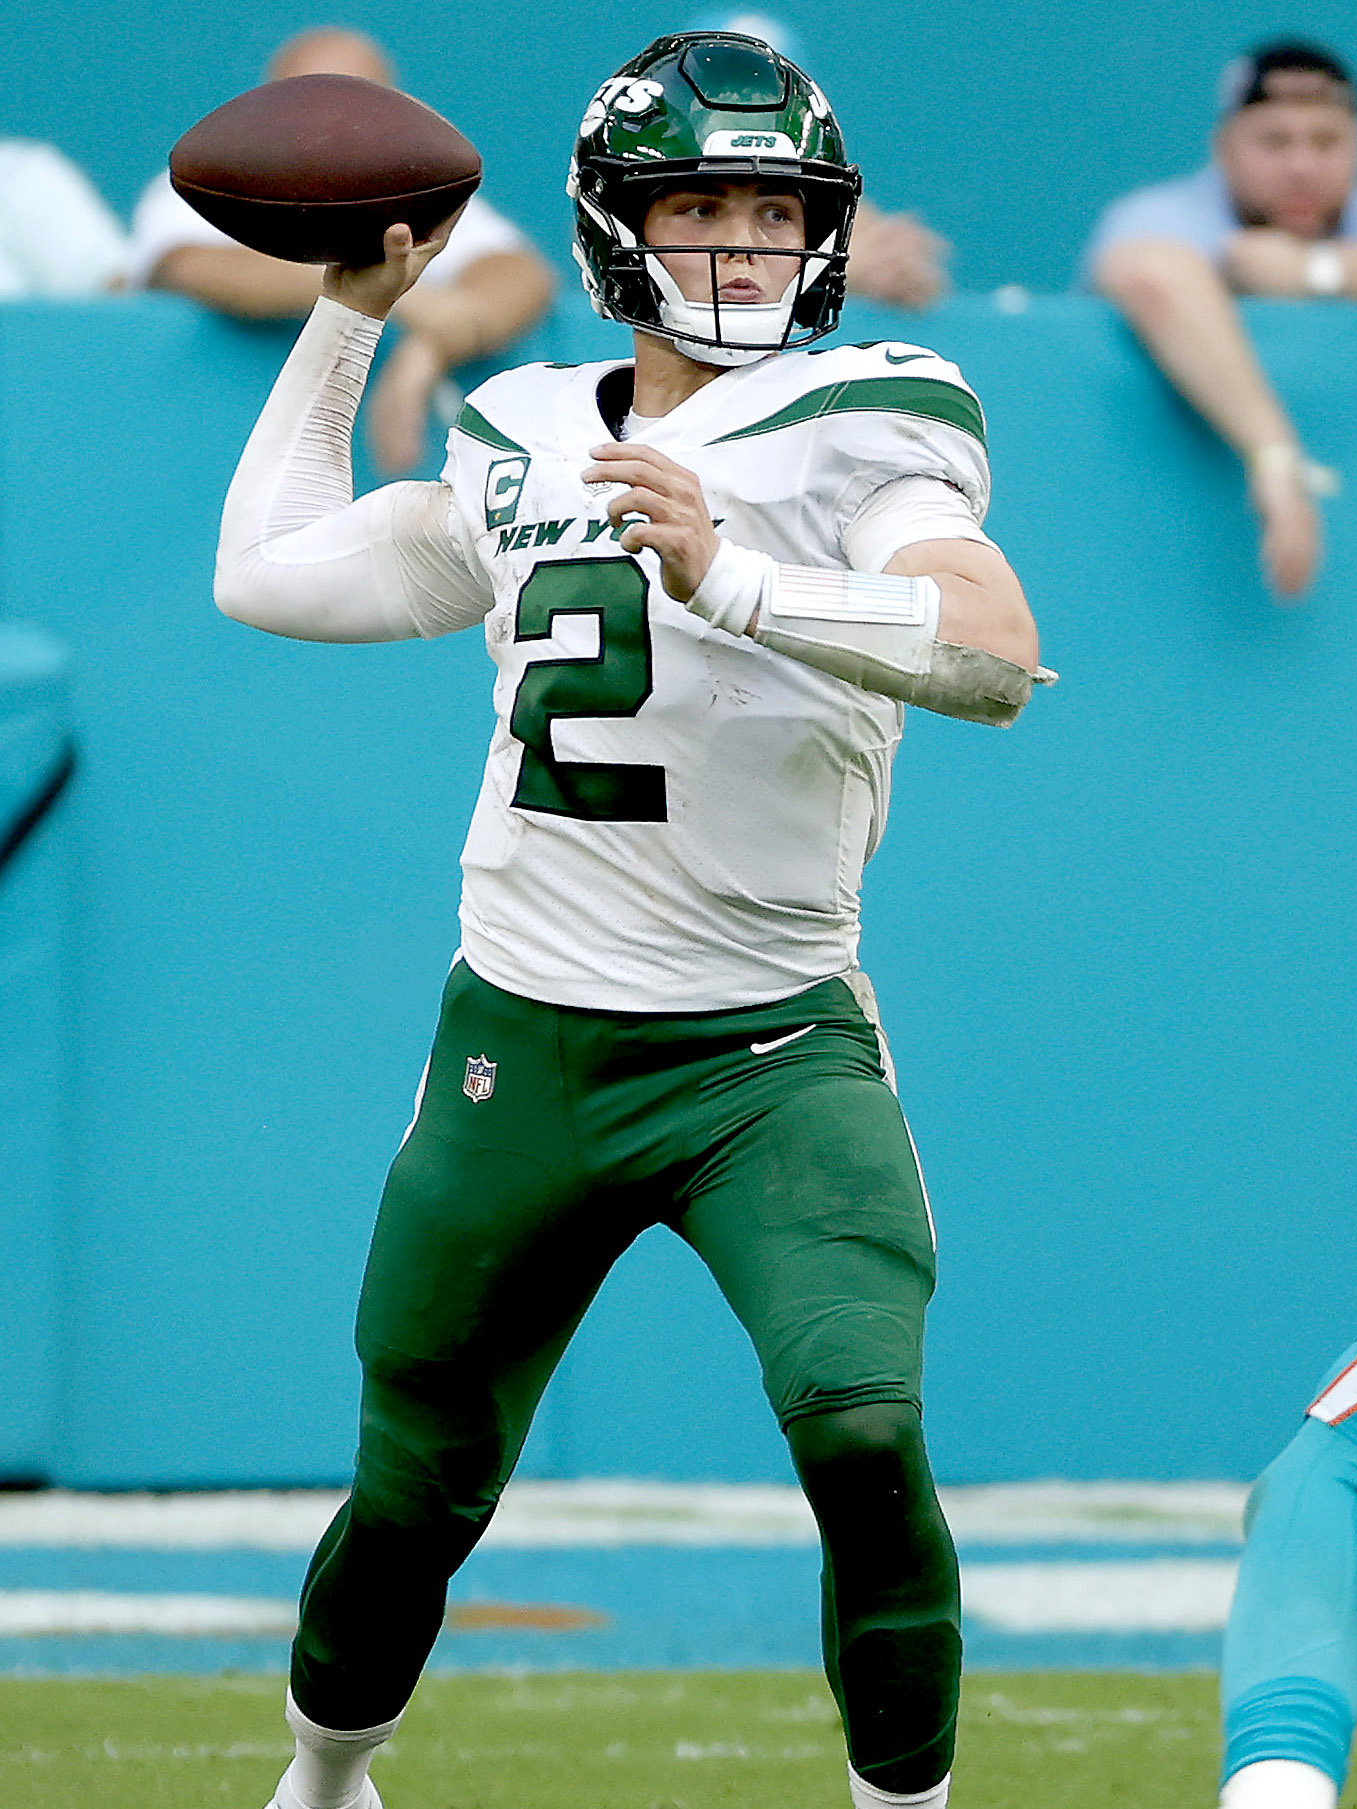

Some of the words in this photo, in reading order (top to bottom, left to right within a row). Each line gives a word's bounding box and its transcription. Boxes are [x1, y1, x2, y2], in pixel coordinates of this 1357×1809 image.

[731, 135, 777, 149] JETS
[486, 460, 527, 512] C
[494, 517, 577, 557] NEW
[509, 555, 668, 823] 2
[468, 1076, 488, 1094] NFL
